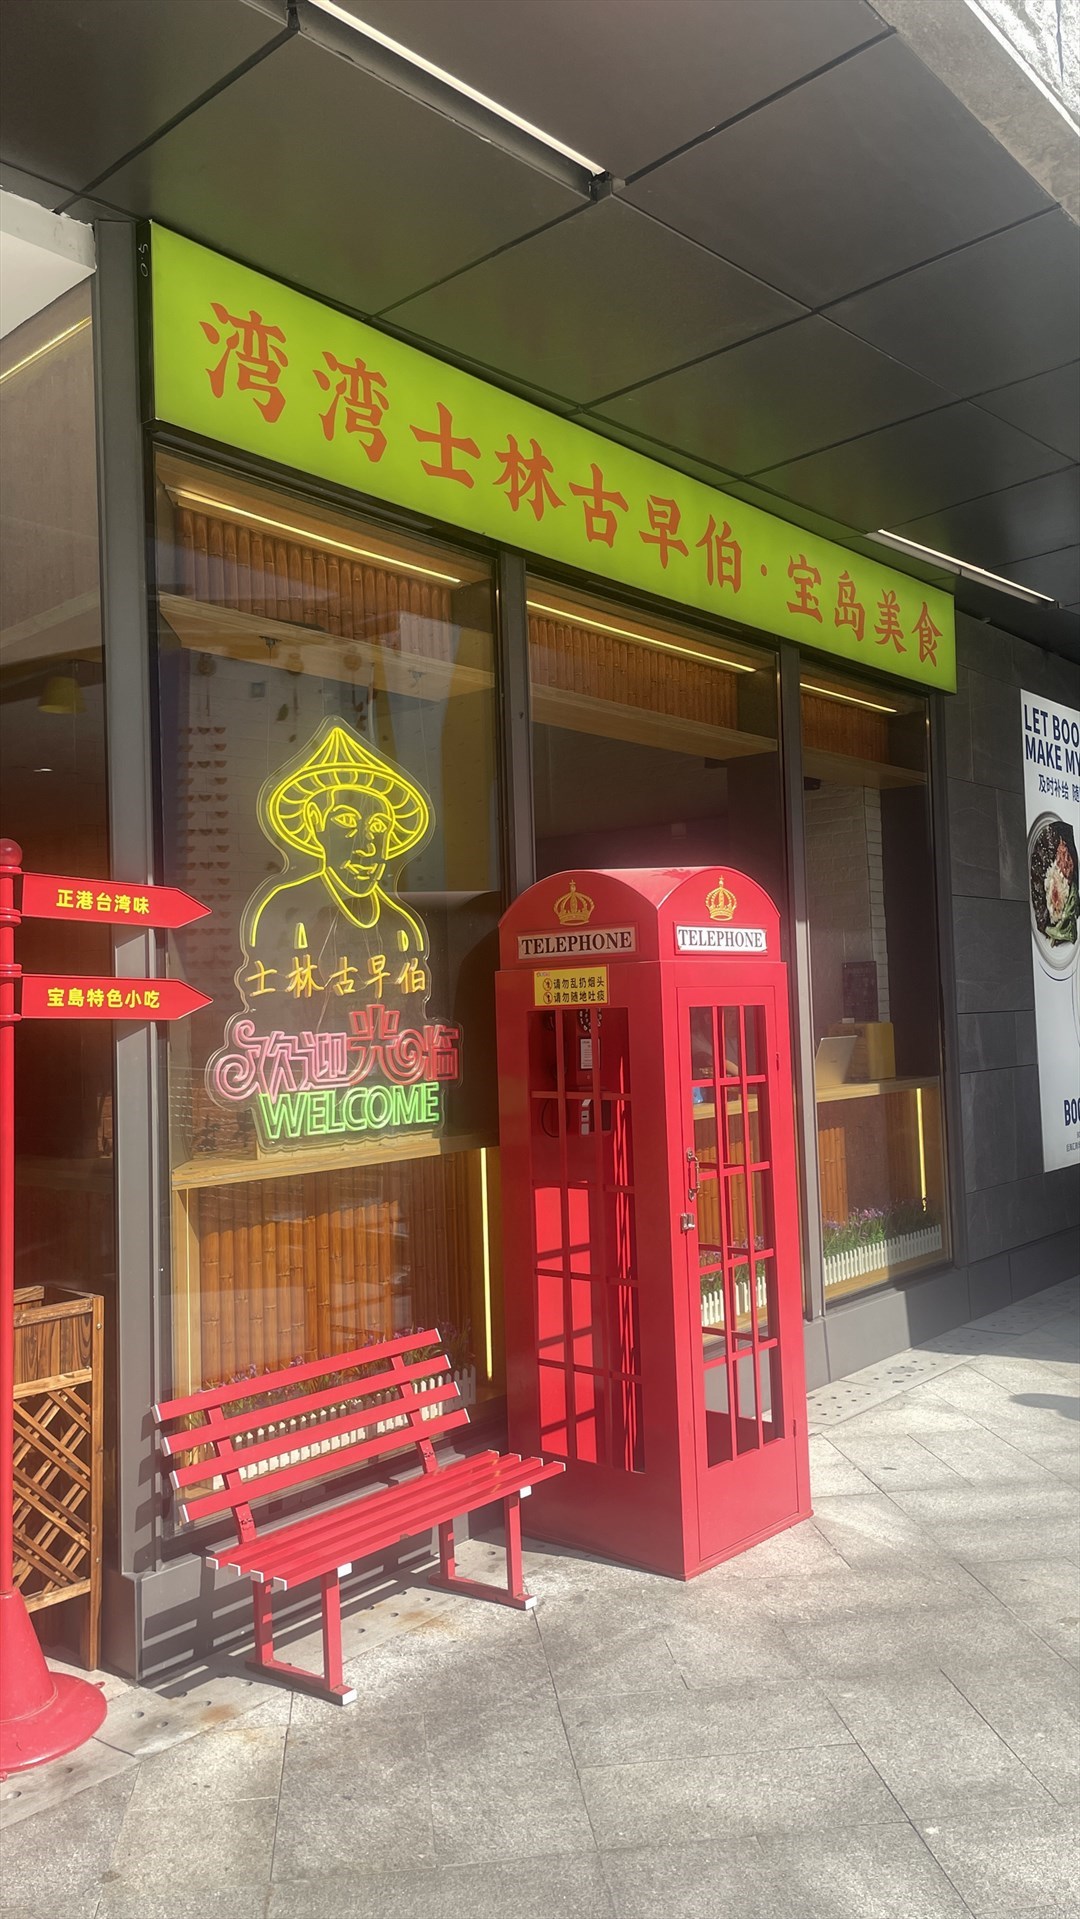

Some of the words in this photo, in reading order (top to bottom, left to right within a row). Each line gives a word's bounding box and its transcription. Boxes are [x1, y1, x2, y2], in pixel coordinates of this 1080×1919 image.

[1024, 704, 1048, 737] LET
[1025, 734, 1062, 771] MAKE
[1038, 773, 1069, 800] 及时补给
[56, 889, 150, 915] 正港台湾味
[521, 931, 632, 955] TELEPHONE
[678, 929, 763, 948] TELEPHONE
[245, 954, 426, 998] 士林古早伯
[553, 976, 605, 990] 请勿乱扔烟头
[553, 990, 605, 1003] 请勿随地吐痰
[215, 1004, 459, 1104] 欢迎光临
[259, 1081, 440, 1140] WELCOME
